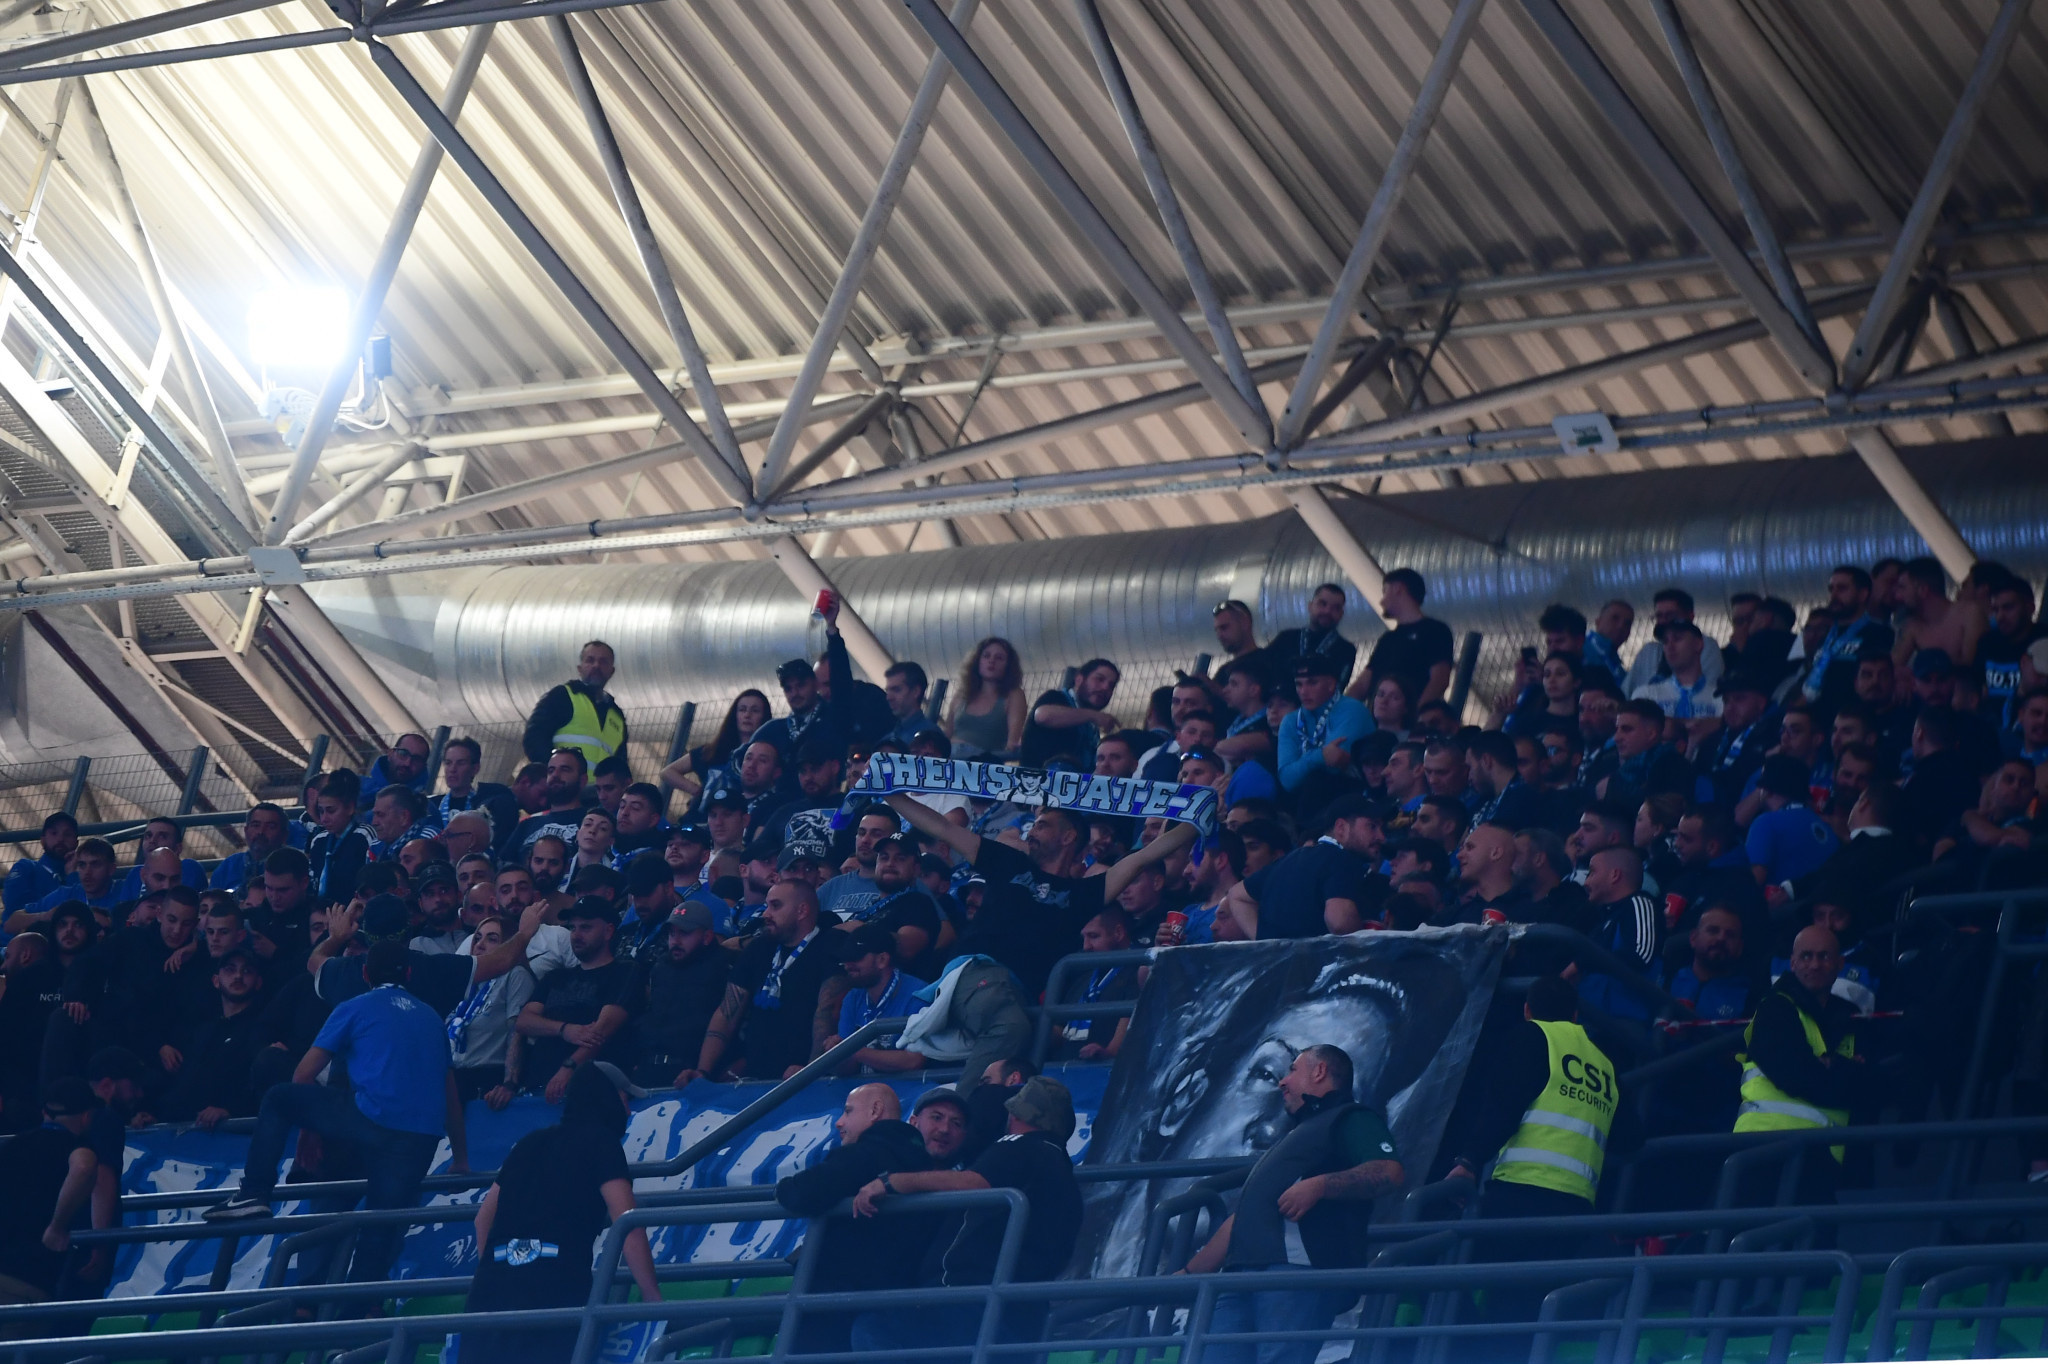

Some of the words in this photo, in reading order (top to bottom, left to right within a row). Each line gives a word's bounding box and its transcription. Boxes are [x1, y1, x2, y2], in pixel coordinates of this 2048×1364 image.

[854, 752, 1016, 797] THENS
[1052, 772, 1181, 817] GATE
[1558, 1084, 1613, 1118] SECURITY
[1561, 1053, 1614, 1103] CSI
